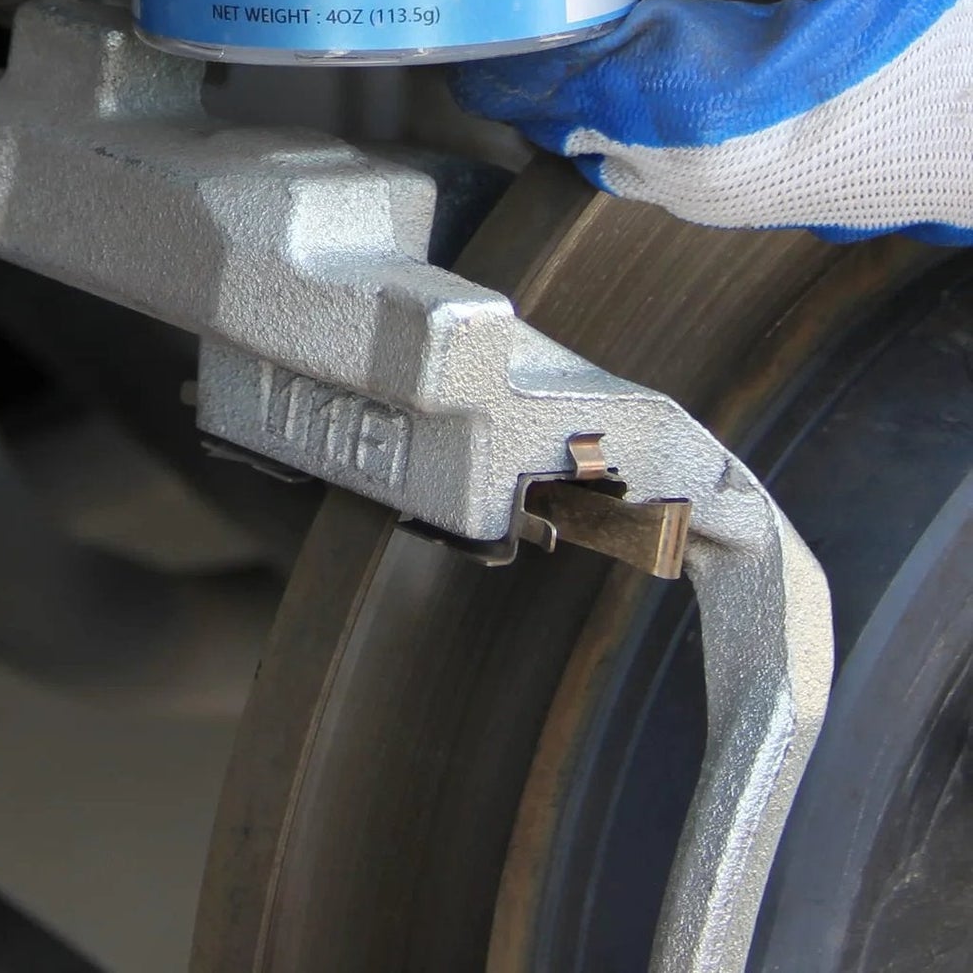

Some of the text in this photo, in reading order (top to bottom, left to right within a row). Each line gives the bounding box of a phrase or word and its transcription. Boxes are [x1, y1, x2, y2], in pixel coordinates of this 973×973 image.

[212, 4, 240, 20] NET
[244, 6, 310, 24] WEIGHT
[326, 9, 364, 24] 4OZ
[369, 6, 441, 26] (113.5g)
